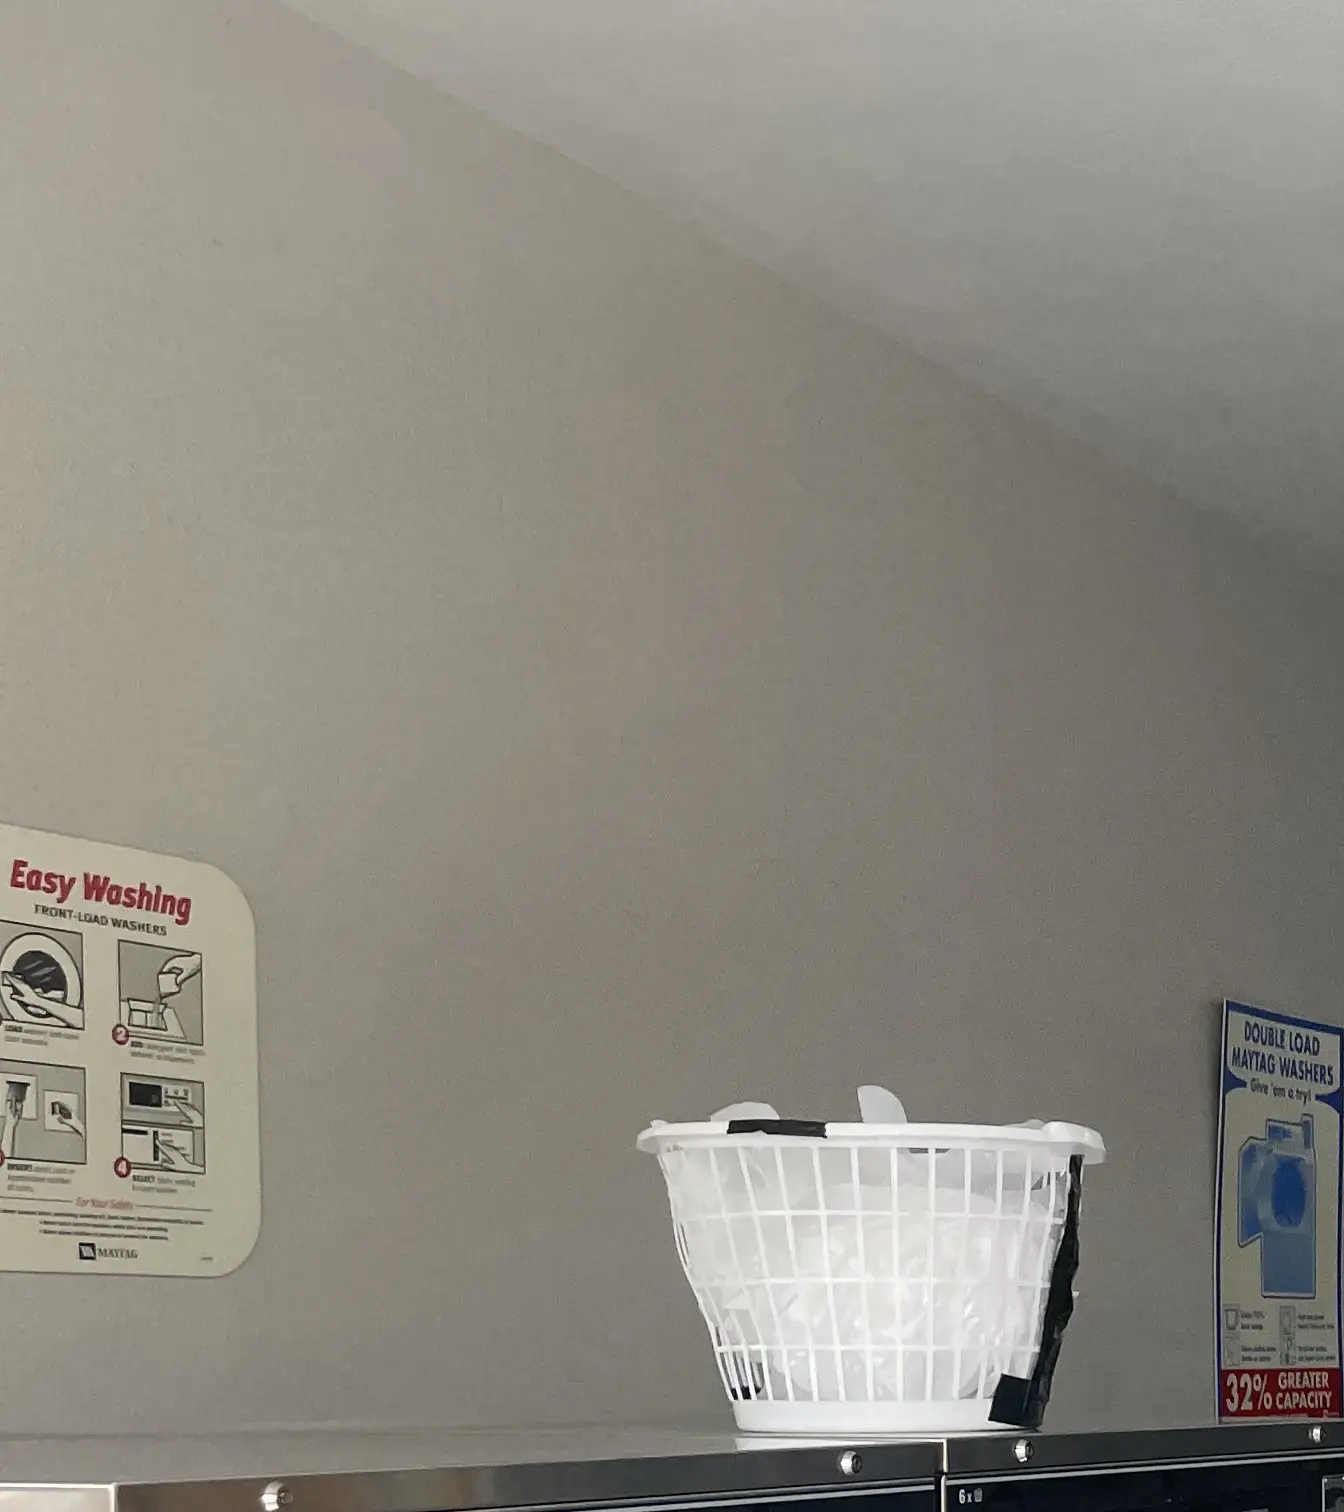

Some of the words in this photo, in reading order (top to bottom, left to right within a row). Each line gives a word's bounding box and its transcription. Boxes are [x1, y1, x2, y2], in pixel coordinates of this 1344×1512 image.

[10, 859, 76, 903] Easy
[83, 872, 192, 926] Washing
[33, 903, 108, 926] FRONT-LOAD
[111, 917, 167, 936] WASHERS
[1244, 1021, 1285, 1049] DOUBLE
[1289, 1031, 1320, 1056] LOAD
[1232, 1046, 1275, 1074] MAYTAG
[1279, 1056, 1334, 1086] WASHERS
[1250, 1077, 1268, 1094] Give
[1288, 1088, 1294, 1099] a
[98, 1248, 138, 1259] MAYTAG
[1226, 1373, 1272, 1412] 32%
[1278, 1371, 1329, 1390] GREATER
[1275, 1391, 1332, 1409] CAPACITY
